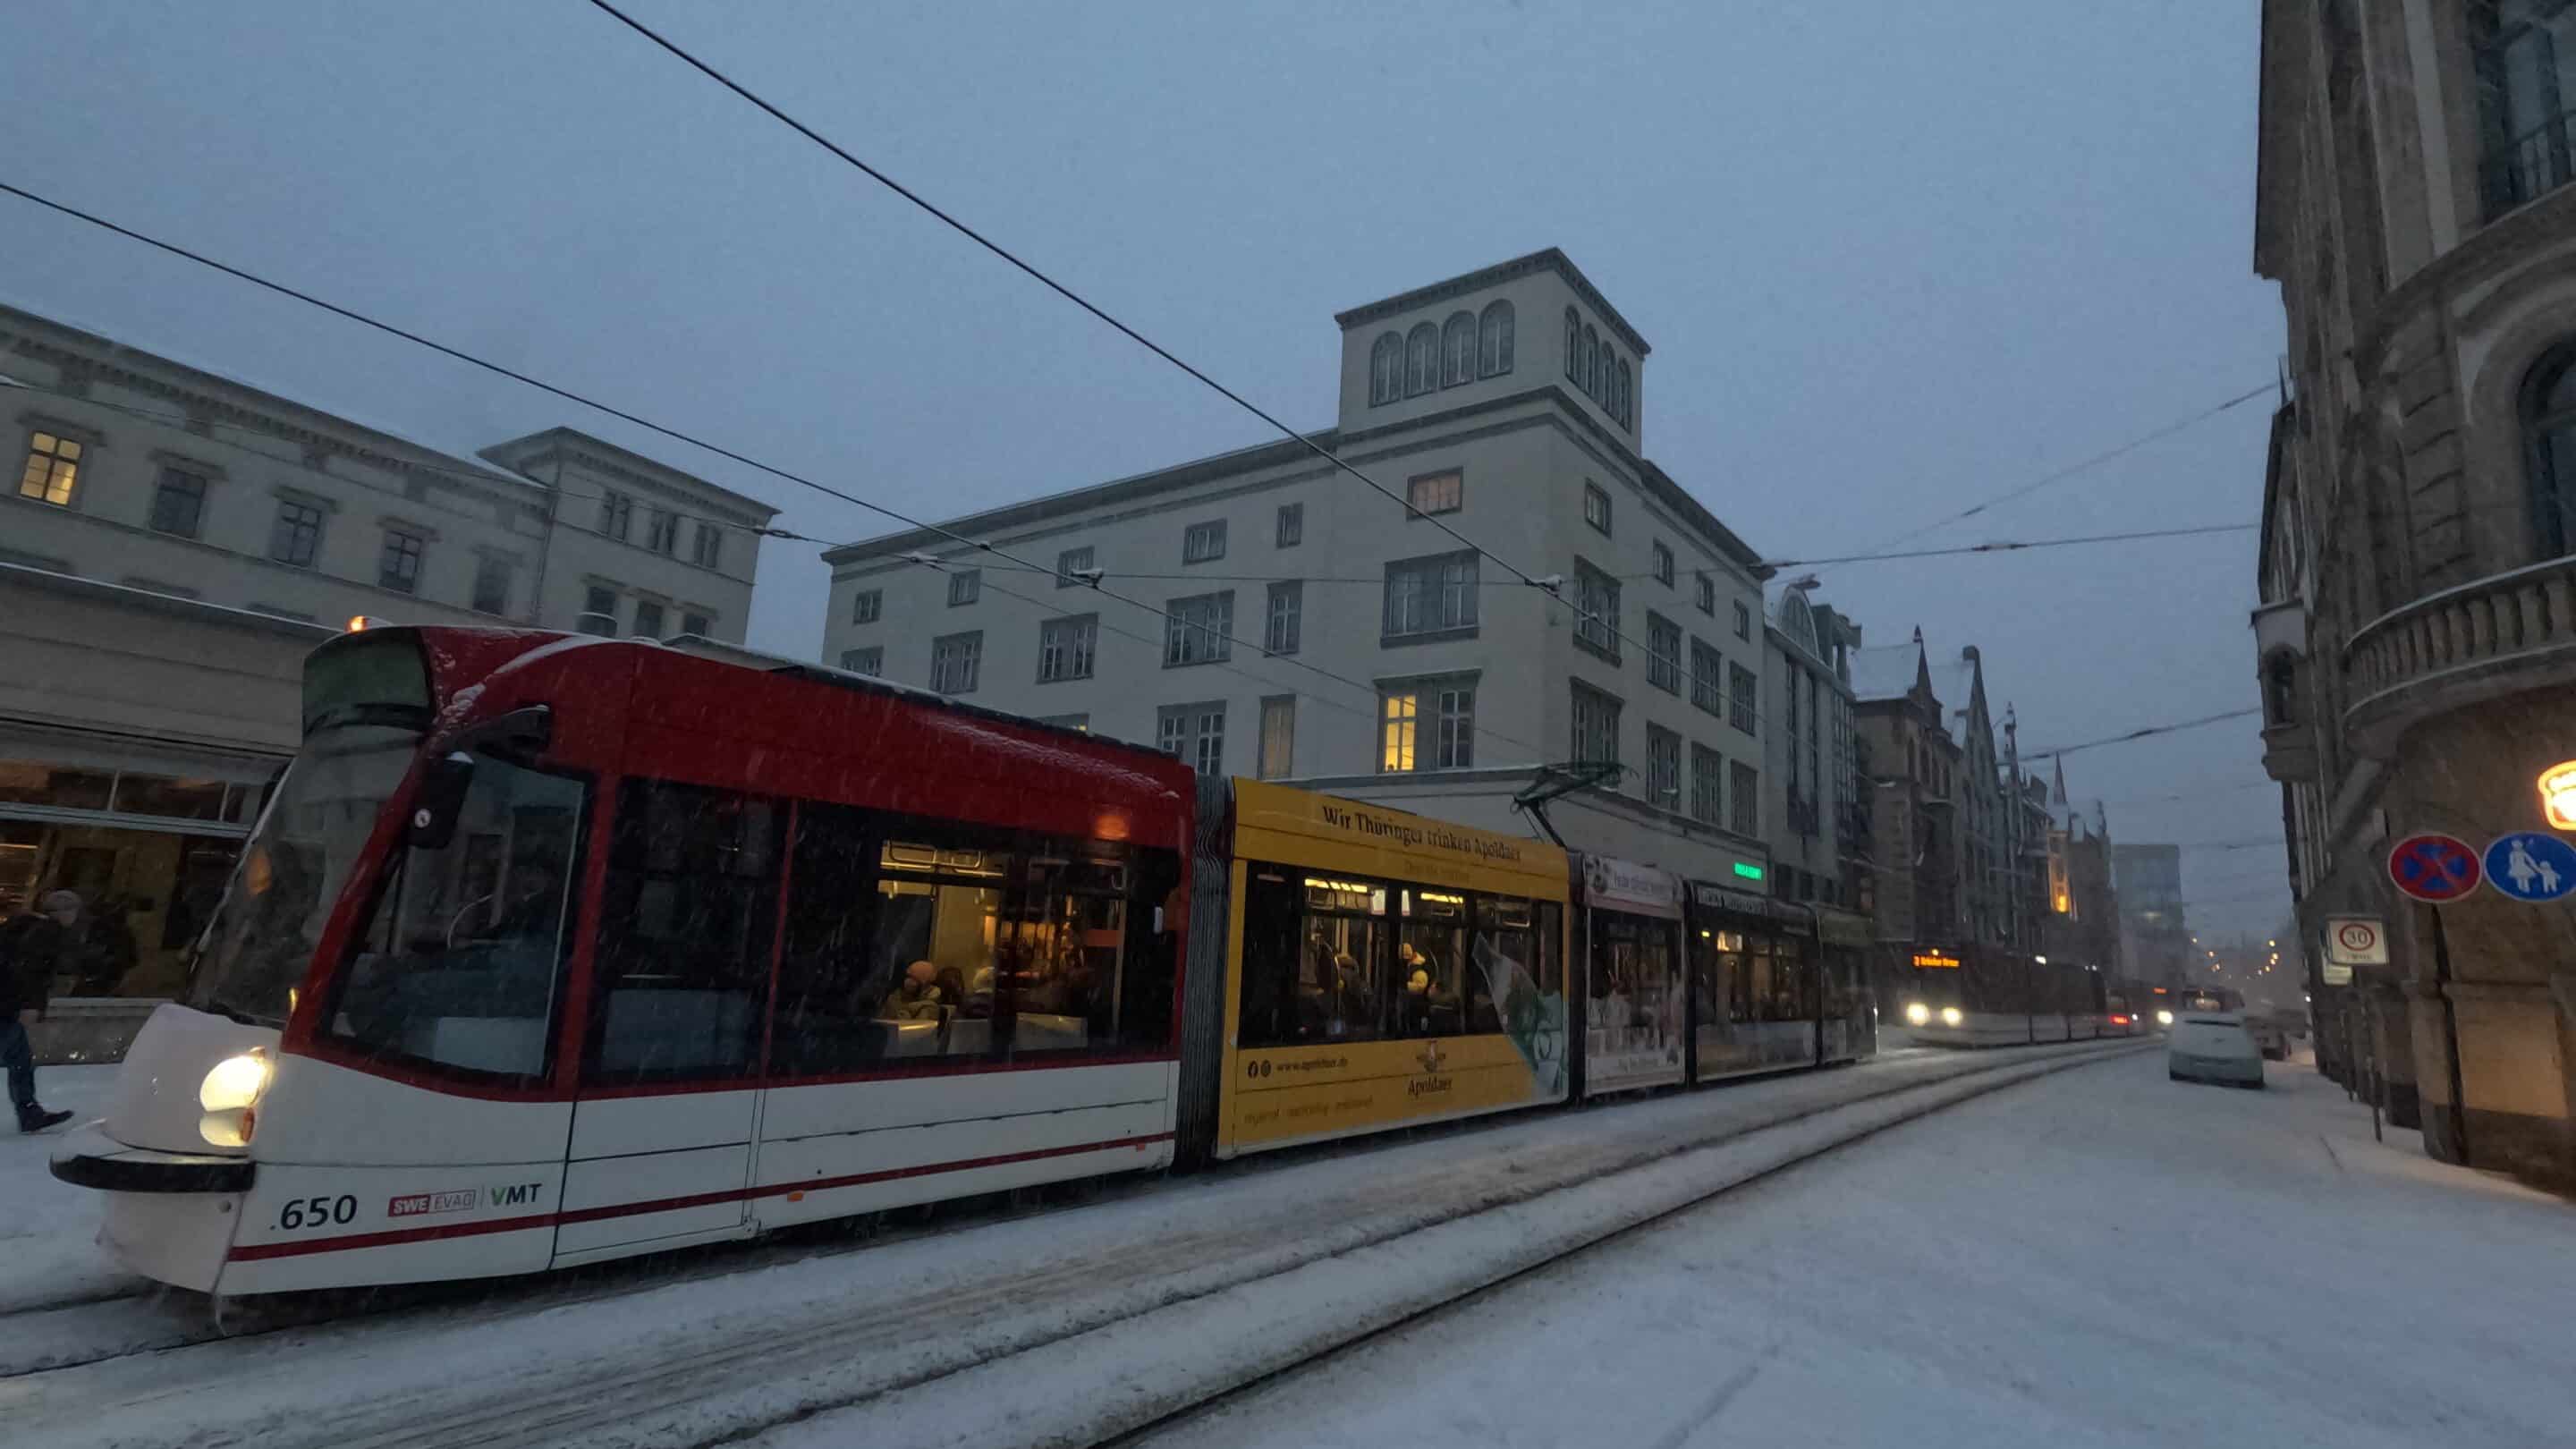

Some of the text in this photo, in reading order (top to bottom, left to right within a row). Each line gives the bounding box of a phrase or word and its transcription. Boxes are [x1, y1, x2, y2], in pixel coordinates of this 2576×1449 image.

[1322, 805, 1352, 832] Wir
[1355, 810, 1423, 847] Thüringer
[1428, 828, 1471, 853] trinken
[2346, 930, 2368, 945] 30
[393, 1192, 472, 1215] SWE EVAG
[490, 1182, 543, 1207] VMT
[280, 1193, 358, 1231] 650
